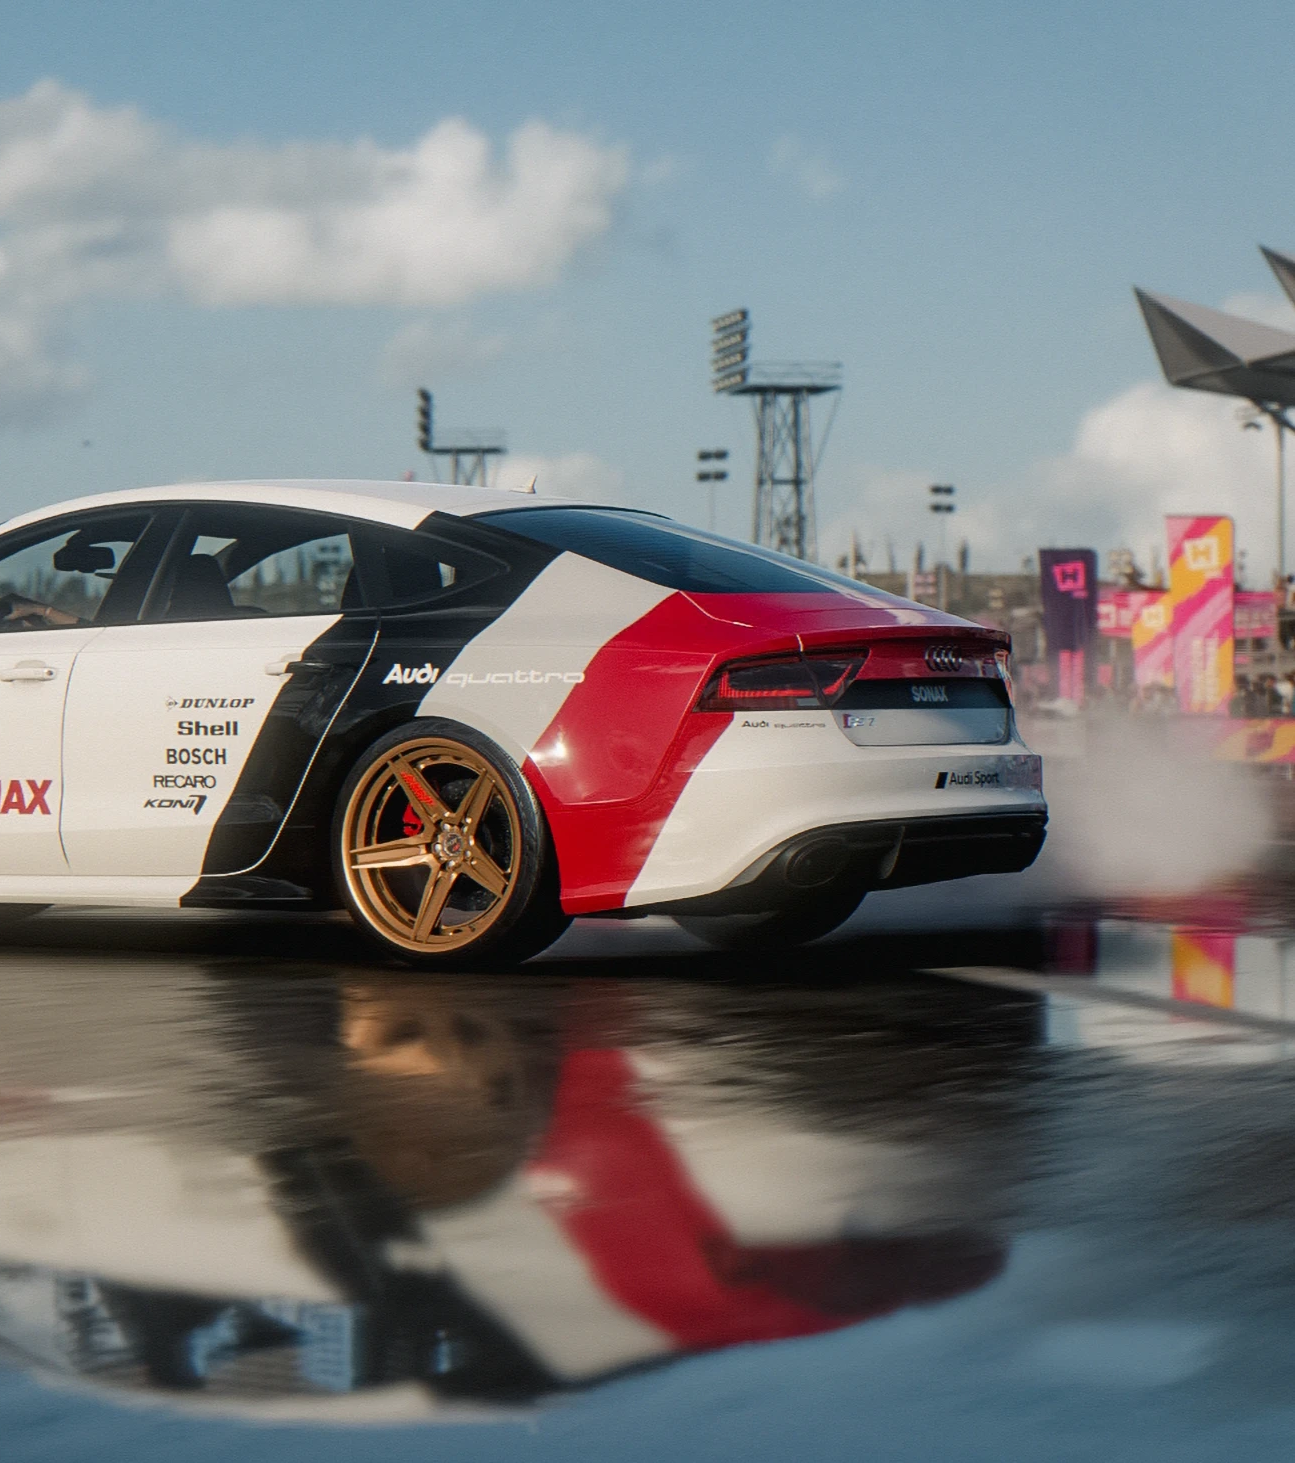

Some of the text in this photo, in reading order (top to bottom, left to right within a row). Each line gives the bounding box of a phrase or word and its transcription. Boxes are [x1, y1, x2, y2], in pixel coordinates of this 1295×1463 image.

[382, 663, 585, 688] Audi quattro
[911, 685, 948, 702] SONAX
[179, 698, 255, 709] DUNLOP
[177, 721, 238, 736] Shell
[741, 720, 769, 728] Audi
[166, 748, 227, 765] BOSCH
[153, 775, 217, 788] RECARO
[949, 771, 1000, 788] Audi Sport
[143, 795, 207, 811] KONI
